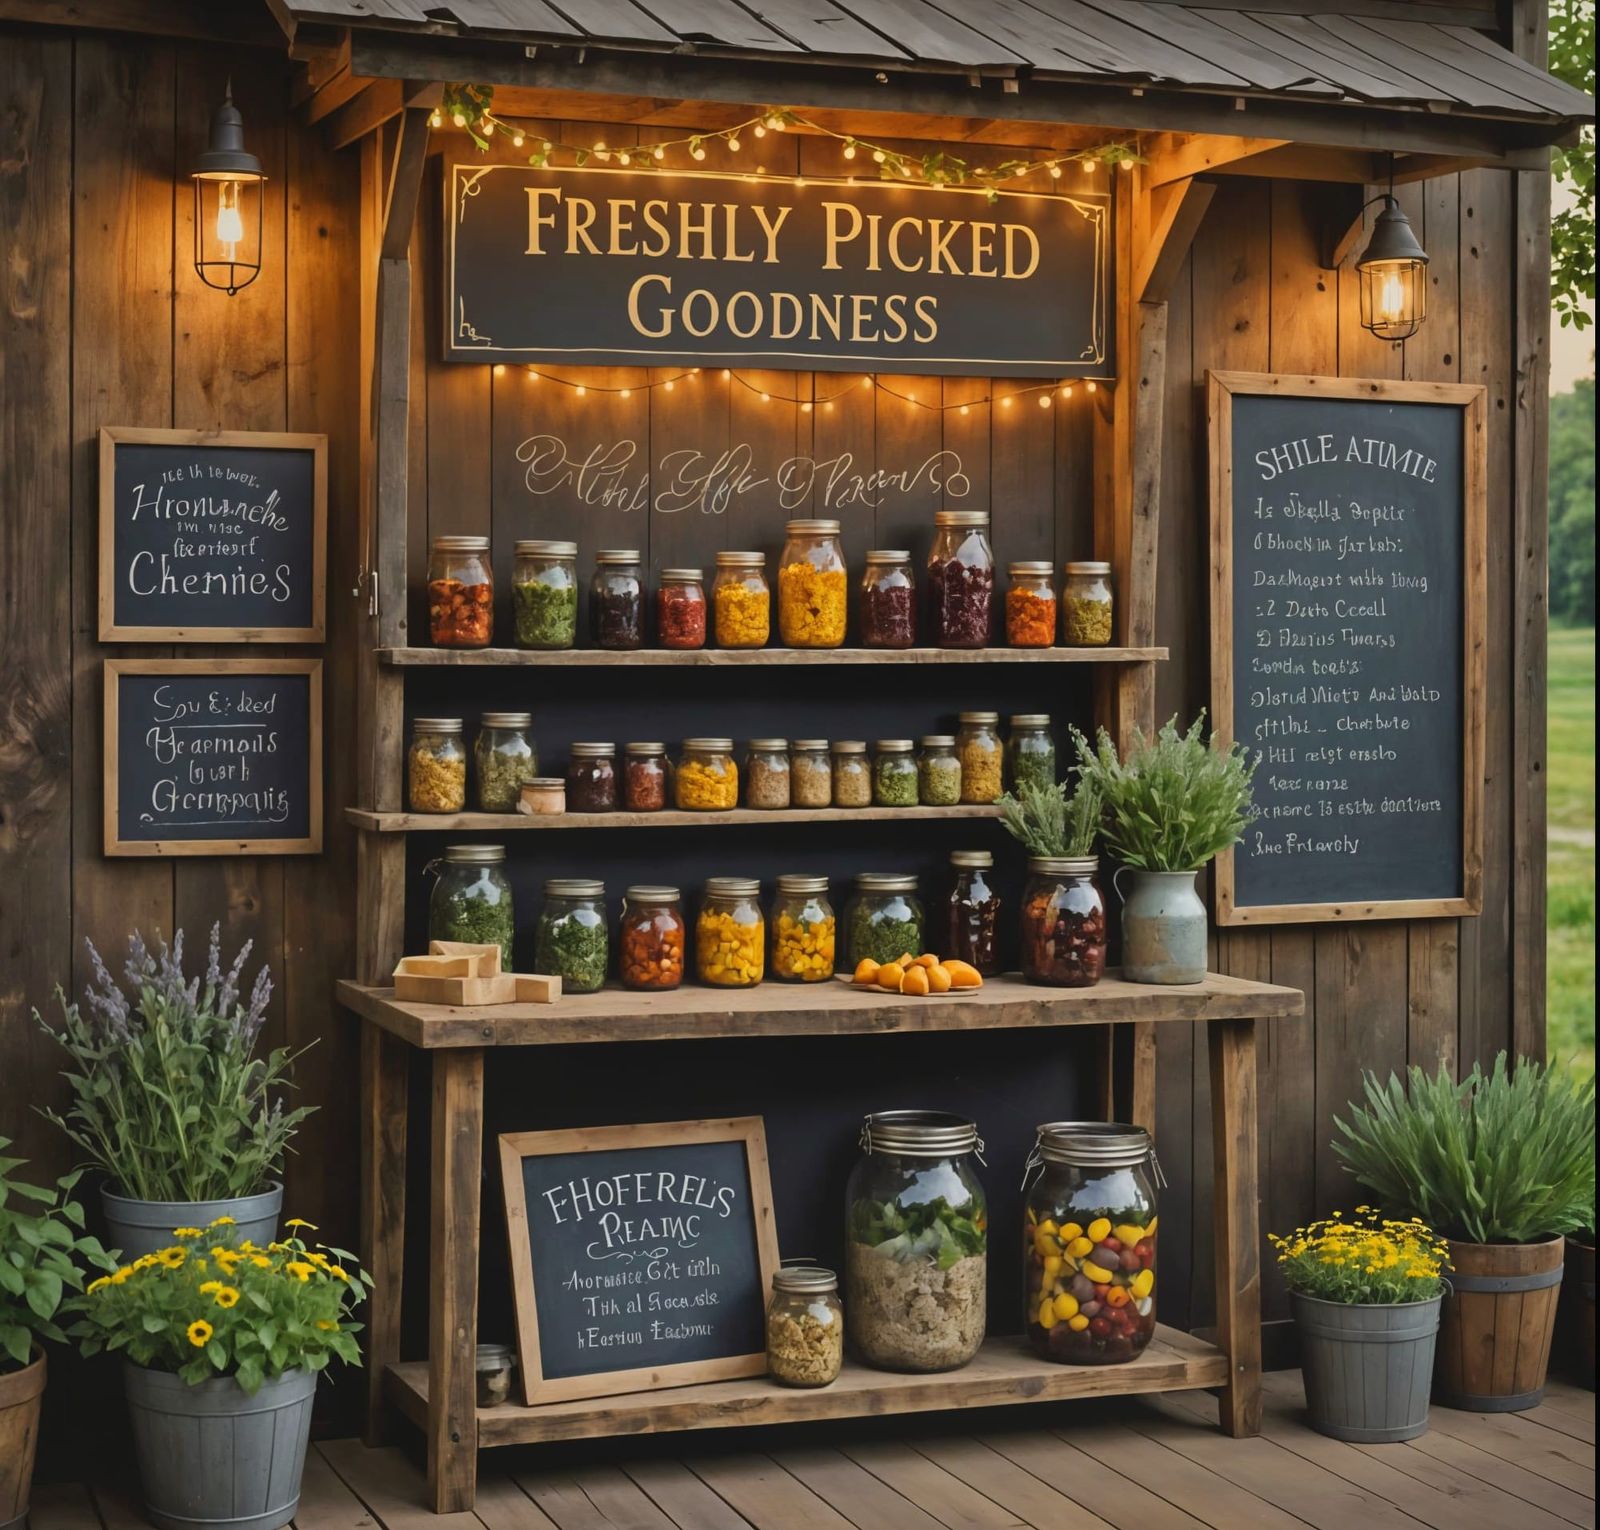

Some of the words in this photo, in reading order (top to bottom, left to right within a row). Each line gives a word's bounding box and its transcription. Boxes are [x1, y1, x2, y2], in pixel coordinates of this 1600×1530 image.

[523, 186, 793, 265] FRESHLY
[821, 201, 1041, 280] PICKED
[626, 273, 940, 344] GOODNESS
[1255, 434, 1338, 480] SHILE
